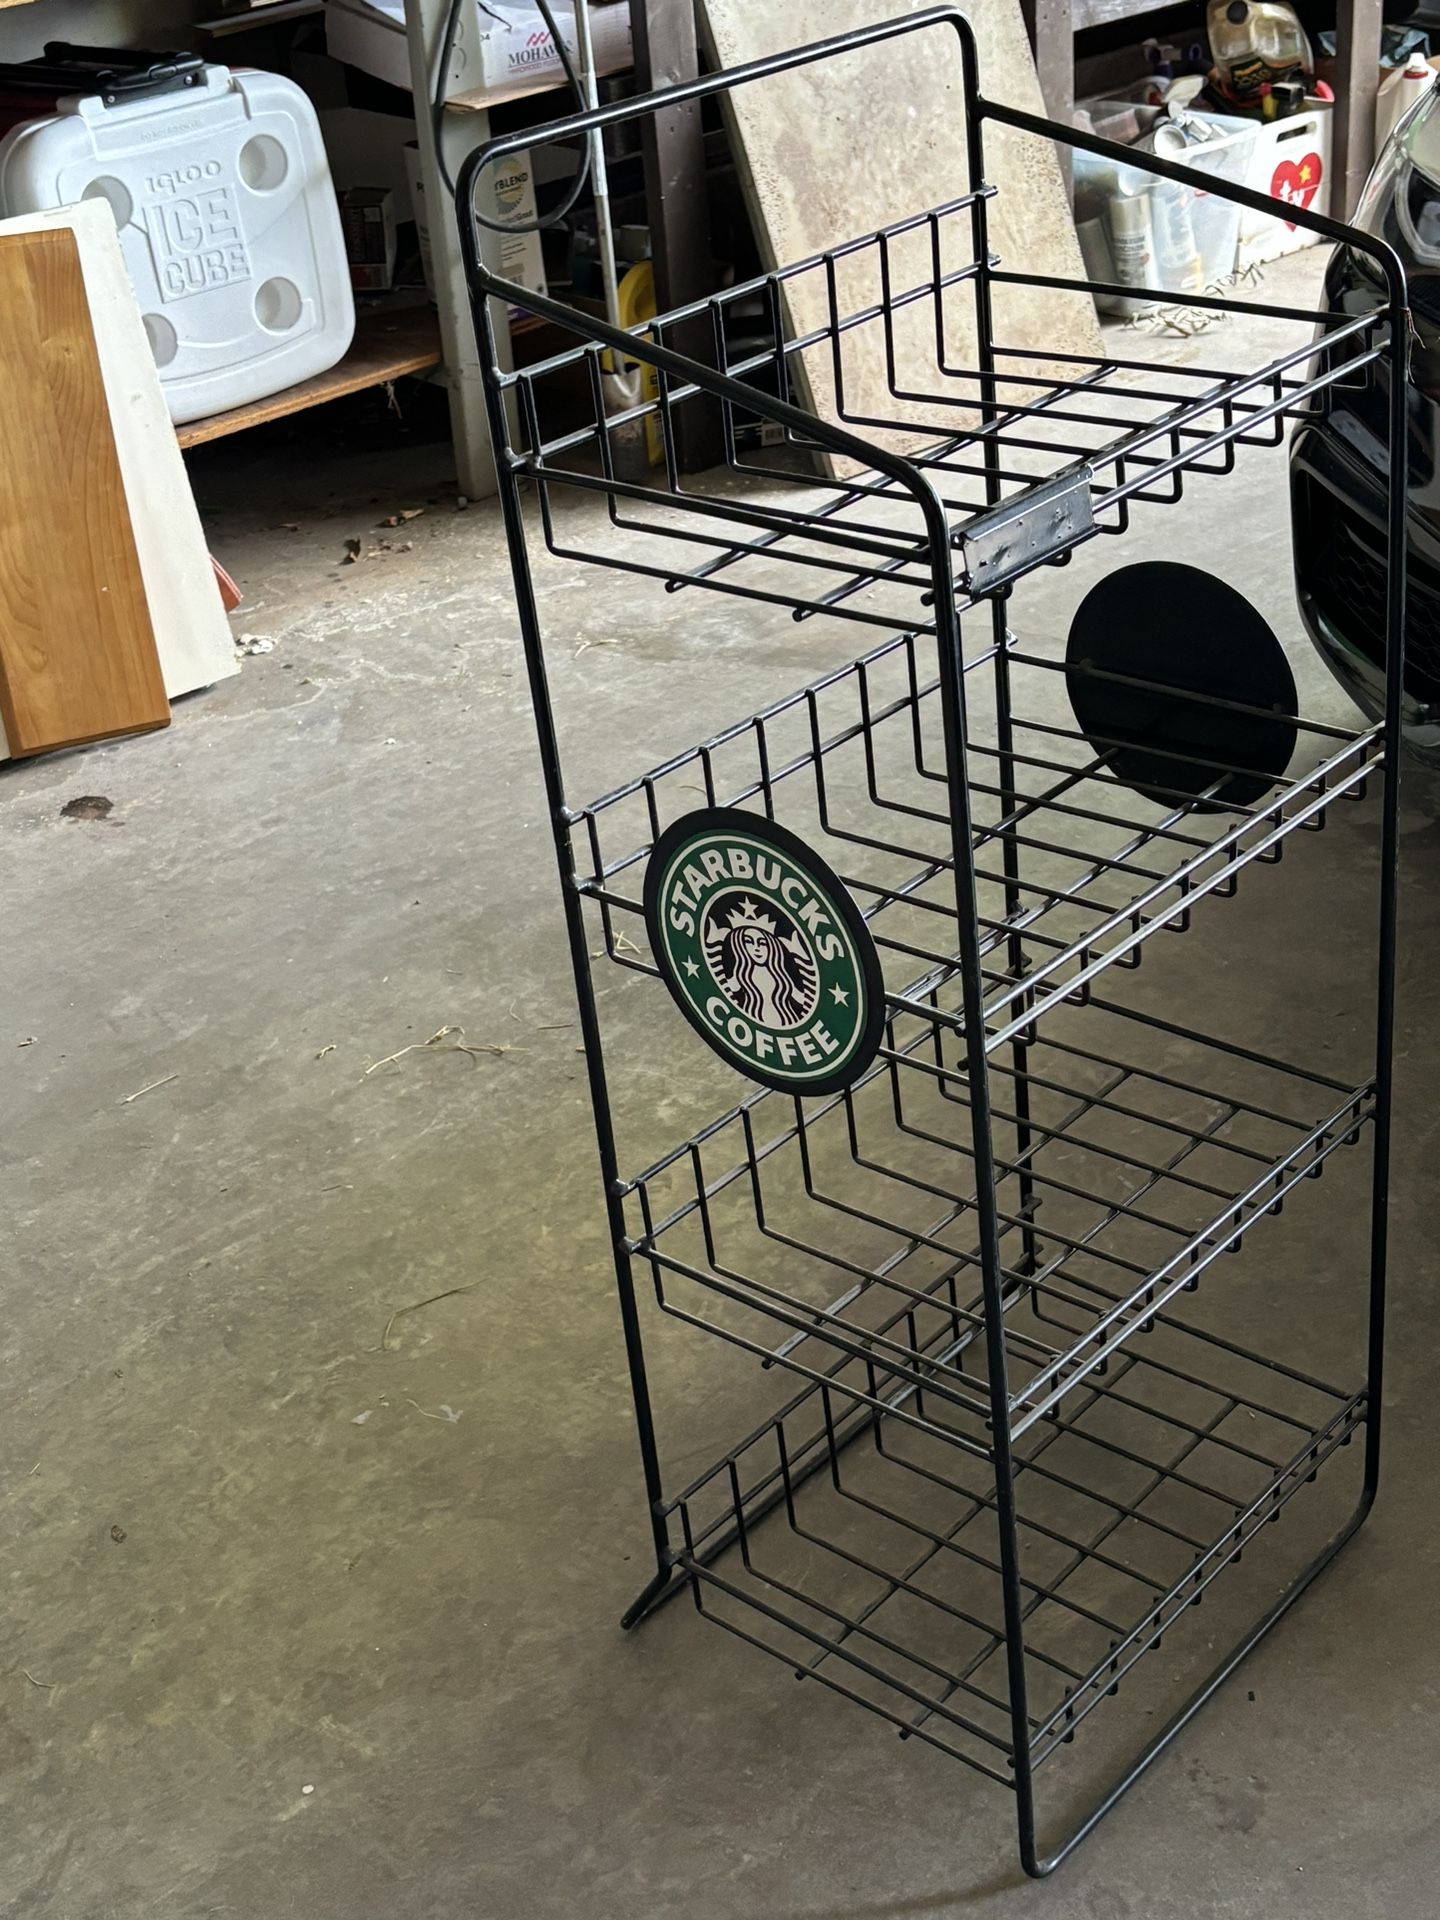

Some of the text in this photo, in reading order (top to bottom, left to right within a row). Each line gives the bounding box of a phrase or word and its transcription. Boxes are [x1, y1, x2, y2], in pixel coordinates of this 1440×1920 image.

[151, 186, 239, 258] ICE
[162, 242, 251, 295] CUBE
[669, 847, 844, 962] STARBUCKS
[705, 995, 841, 1067] COFFEE
